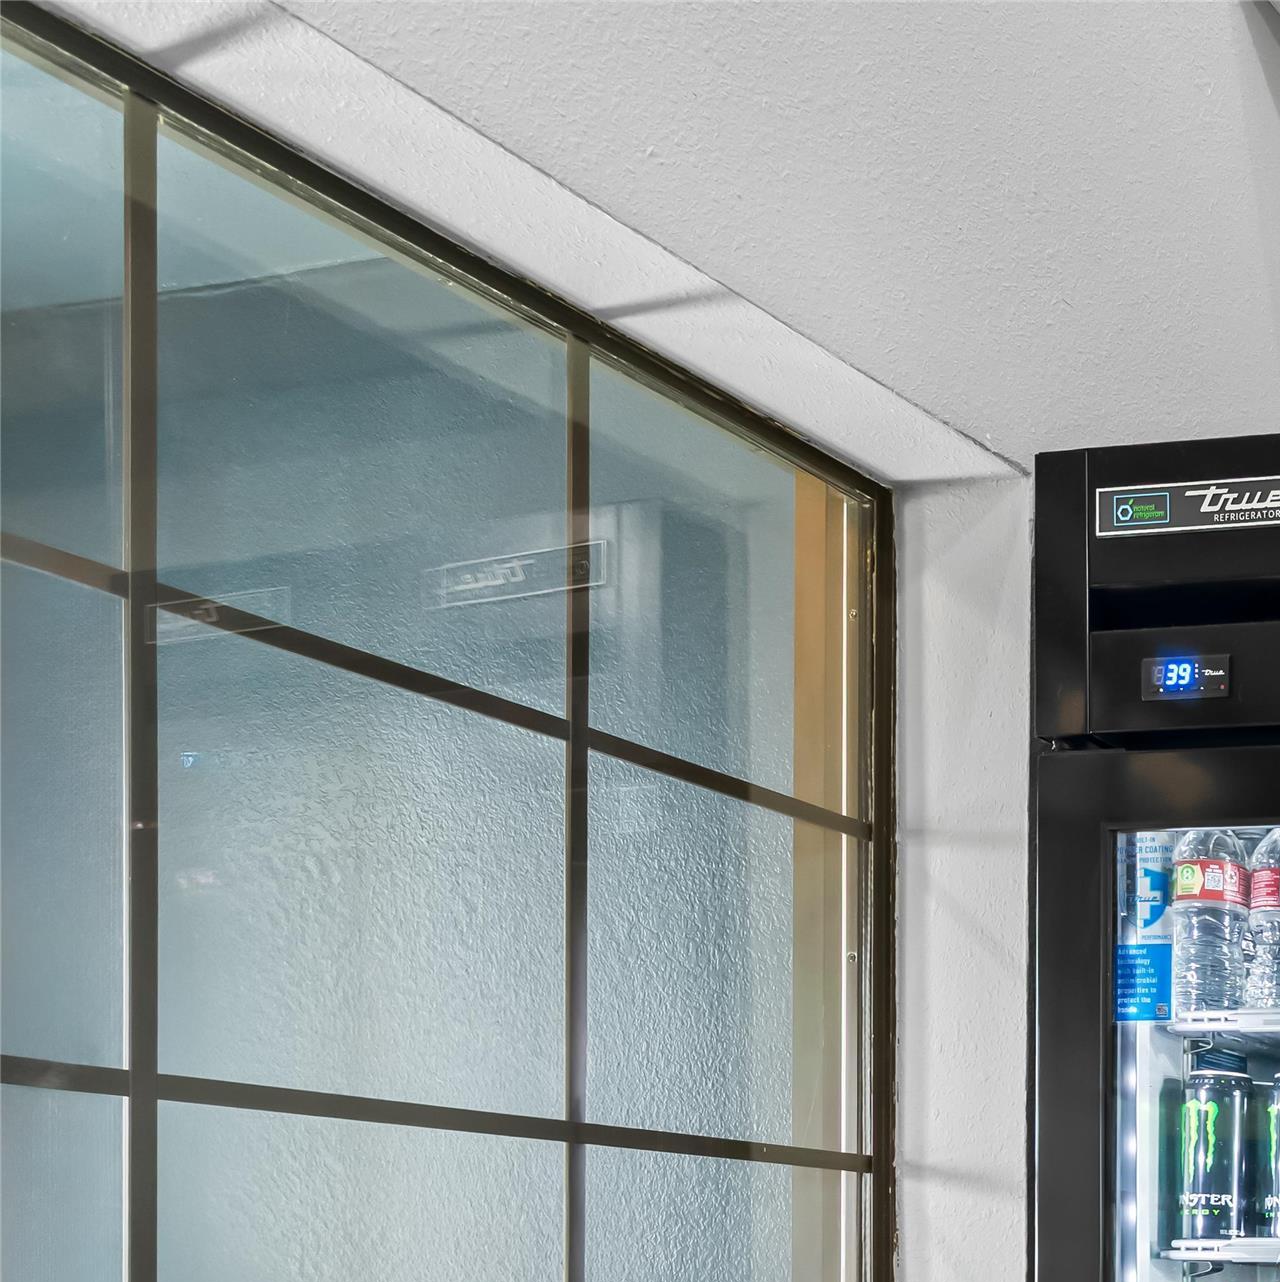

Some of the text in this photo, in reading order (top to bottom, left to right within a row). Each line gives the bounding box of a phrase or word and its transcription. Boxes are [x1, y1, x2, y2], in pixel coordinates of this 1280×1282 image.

[1213, 510, 1280, 522] REFRIGERATOR
[1165, 663, 1192, 686] 39
[1145, 845, 1174, 854] COATING
